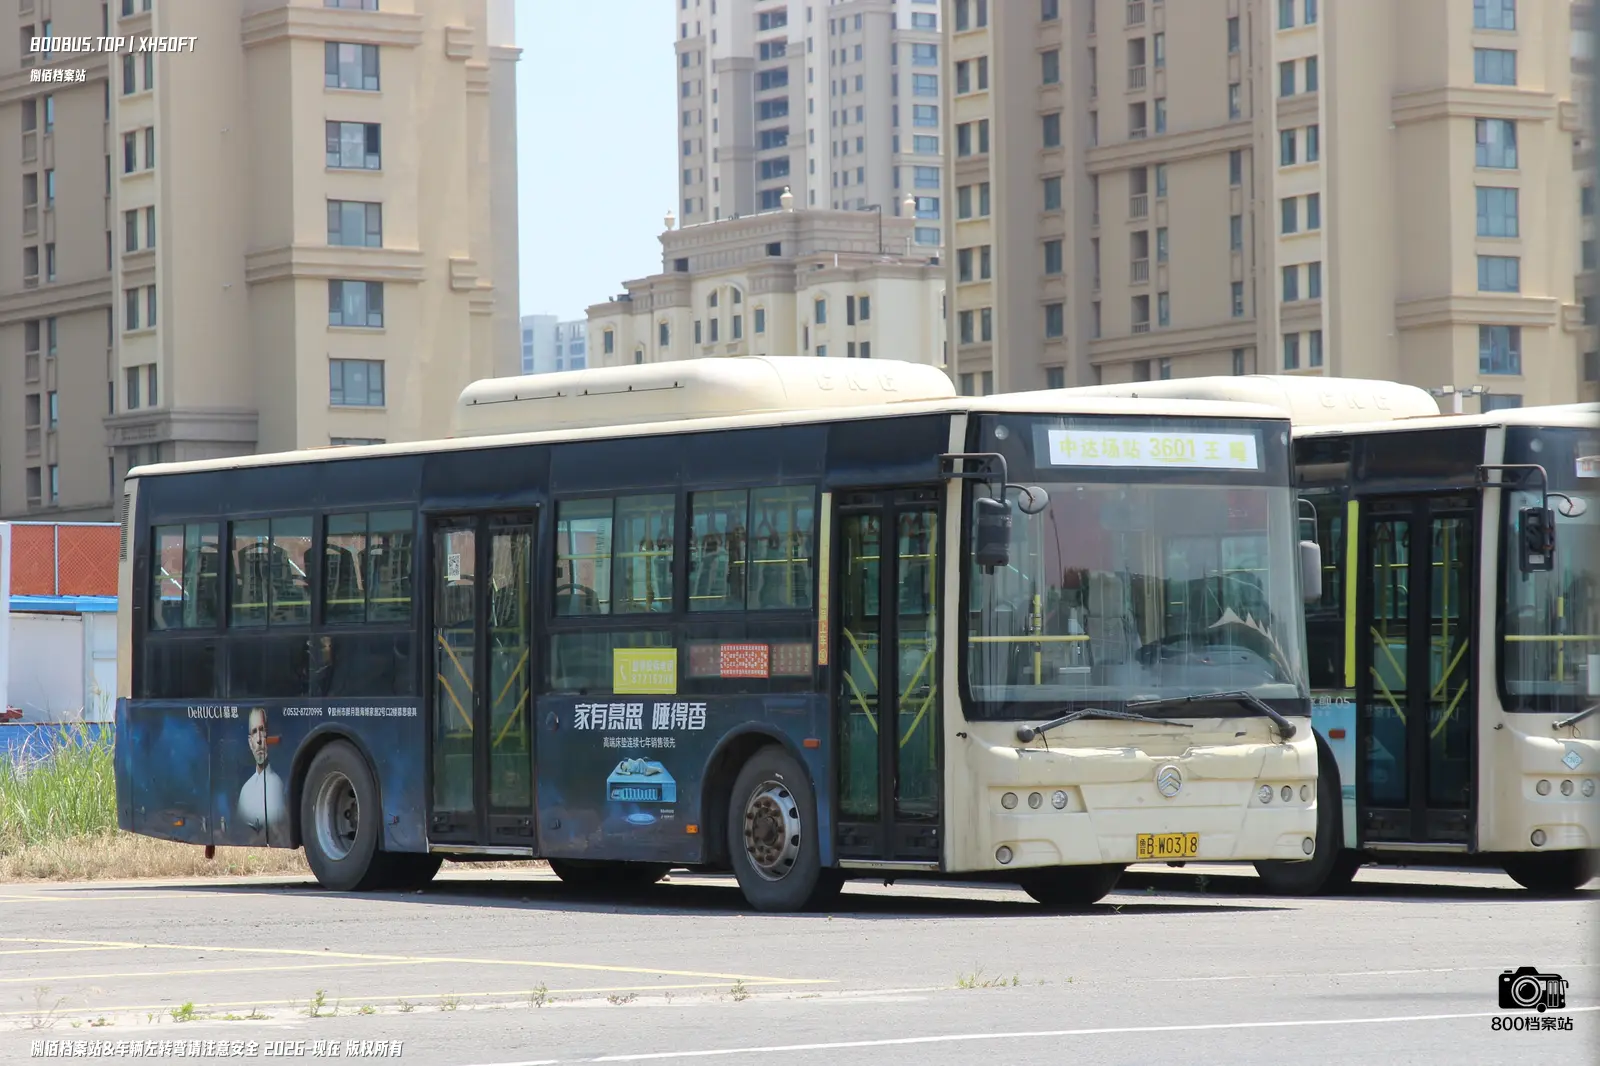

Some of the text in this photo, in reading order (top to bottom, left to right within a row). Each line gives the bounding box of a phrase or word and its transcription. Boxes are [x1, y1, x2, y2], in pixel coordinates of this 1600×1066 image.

[1149, 437, 1197, 458] 3601
[574, 703, 707, 730] 家有慕思 睡得香
[603, 736, 676, 749] 高端床垫连续七年销售领先
